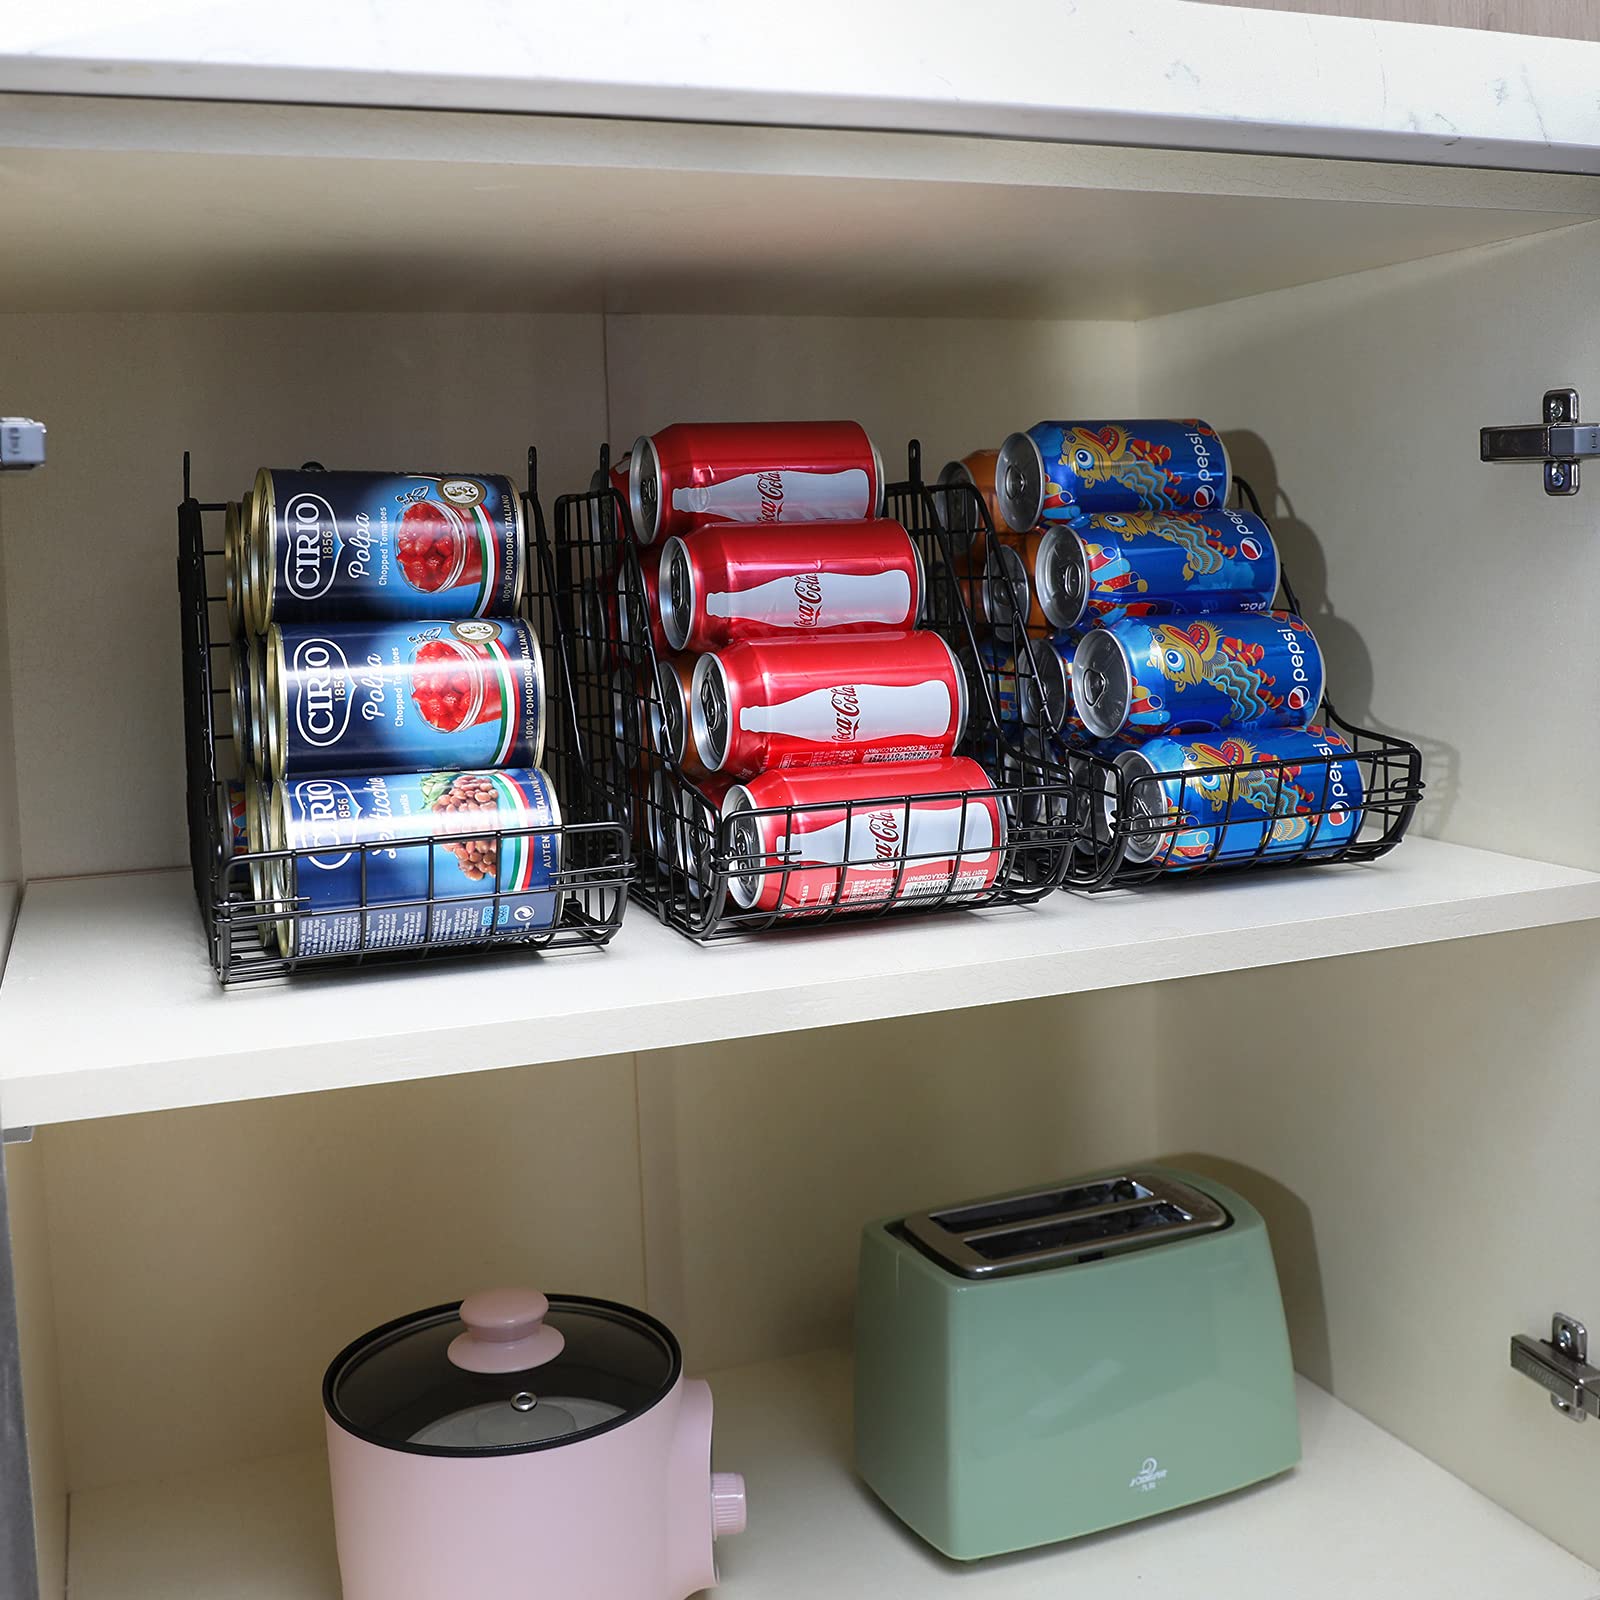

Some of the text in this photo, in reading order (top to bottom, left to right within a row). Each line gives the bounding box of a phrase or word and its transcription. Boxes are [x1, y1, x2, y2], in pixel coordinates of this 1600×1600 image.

[1185, 433, 1213, 481] pepsi
[295, 502, 320, 589] CIRIO
[323, 530, 333, 559] 1856
[348, 512, 379, 579] Polpa
[379, 506, 390, 586] Chopped Tomatoes
[501, 495, 514, 602] 100% POMODORO ITALIANO
[1277, 629, 1308, 681] pepsi
[305, 647, 334, 734] CIRIO
[334, 671, 346, 702] 1856
[392, 647, 405, 727] Chopped Totoes
[523, 663, 534, 714] POMODORO
[525, 716, 534, 739] 100%
[337, 798, 351, 822] 856
[541, 814, 552, 868] AUTENCO
[906, 874, 931, 882] COMPANY
[932, 871, 961, 879] CCA-COLA
